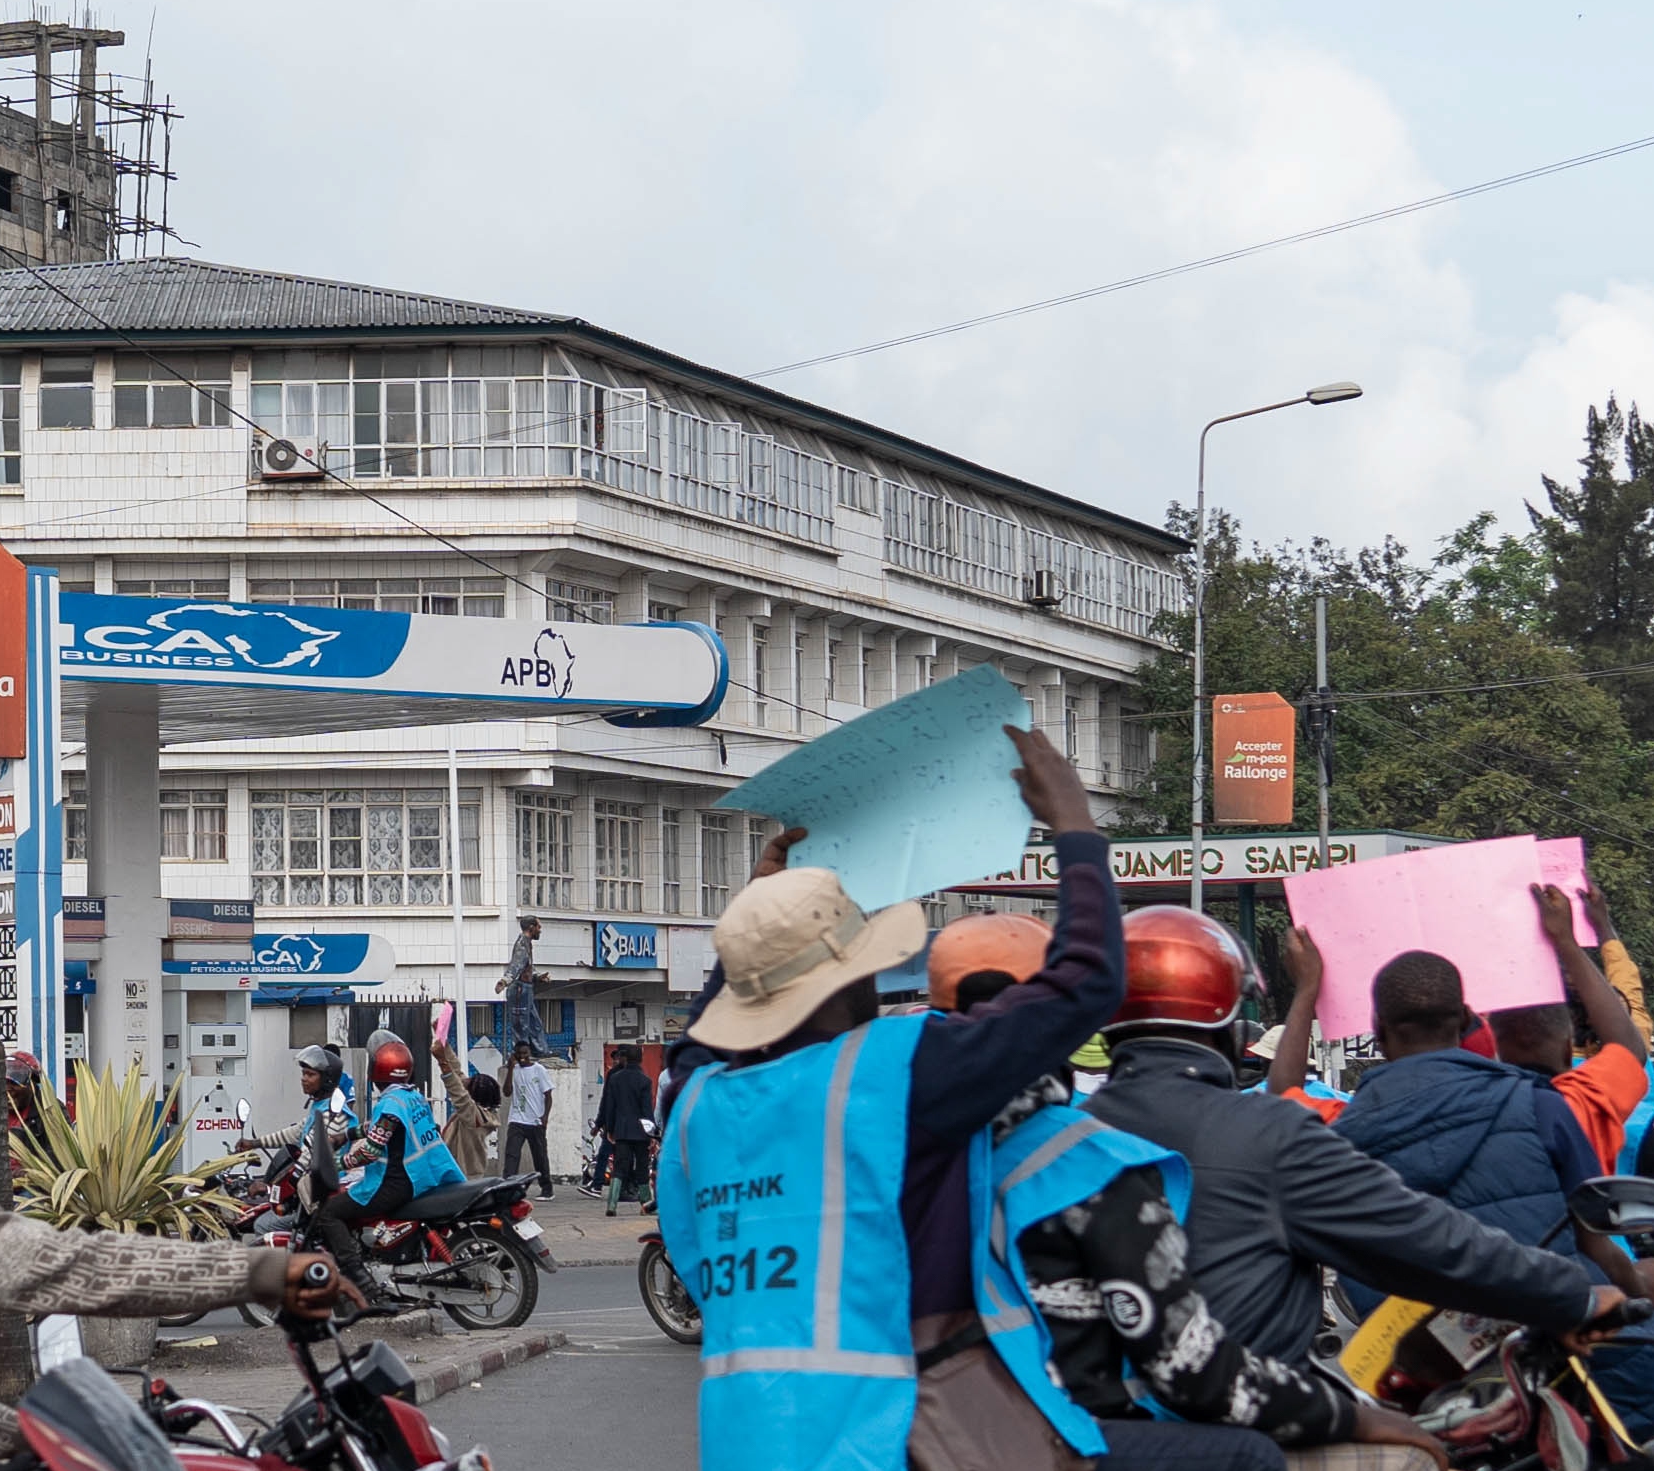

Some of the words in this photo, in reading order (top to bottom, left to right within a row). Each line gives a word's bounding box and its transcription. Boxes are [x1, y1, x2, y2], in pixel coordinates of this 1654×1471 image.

[61, 650, 235, 667] BUSINESS
[500, 657, 552, 687] APB
[1235, 741, 1282, 753] Accepter
[1246, 754, 1287, 765] m-pesa
[1224, 765, 1287, 781] Rallonge
[64, 901, 102, 913] DIESEL
[213, 905, 251, 916] DIESEL
[172, 923, 213, 935] ESSENCE
[619, 935, 657, 957] BAJAJ
[126, 983, 138, 997] NO
[126, 1001, 148, 1010] SMOKING
[698, 1245, 799, 1302] 0312
